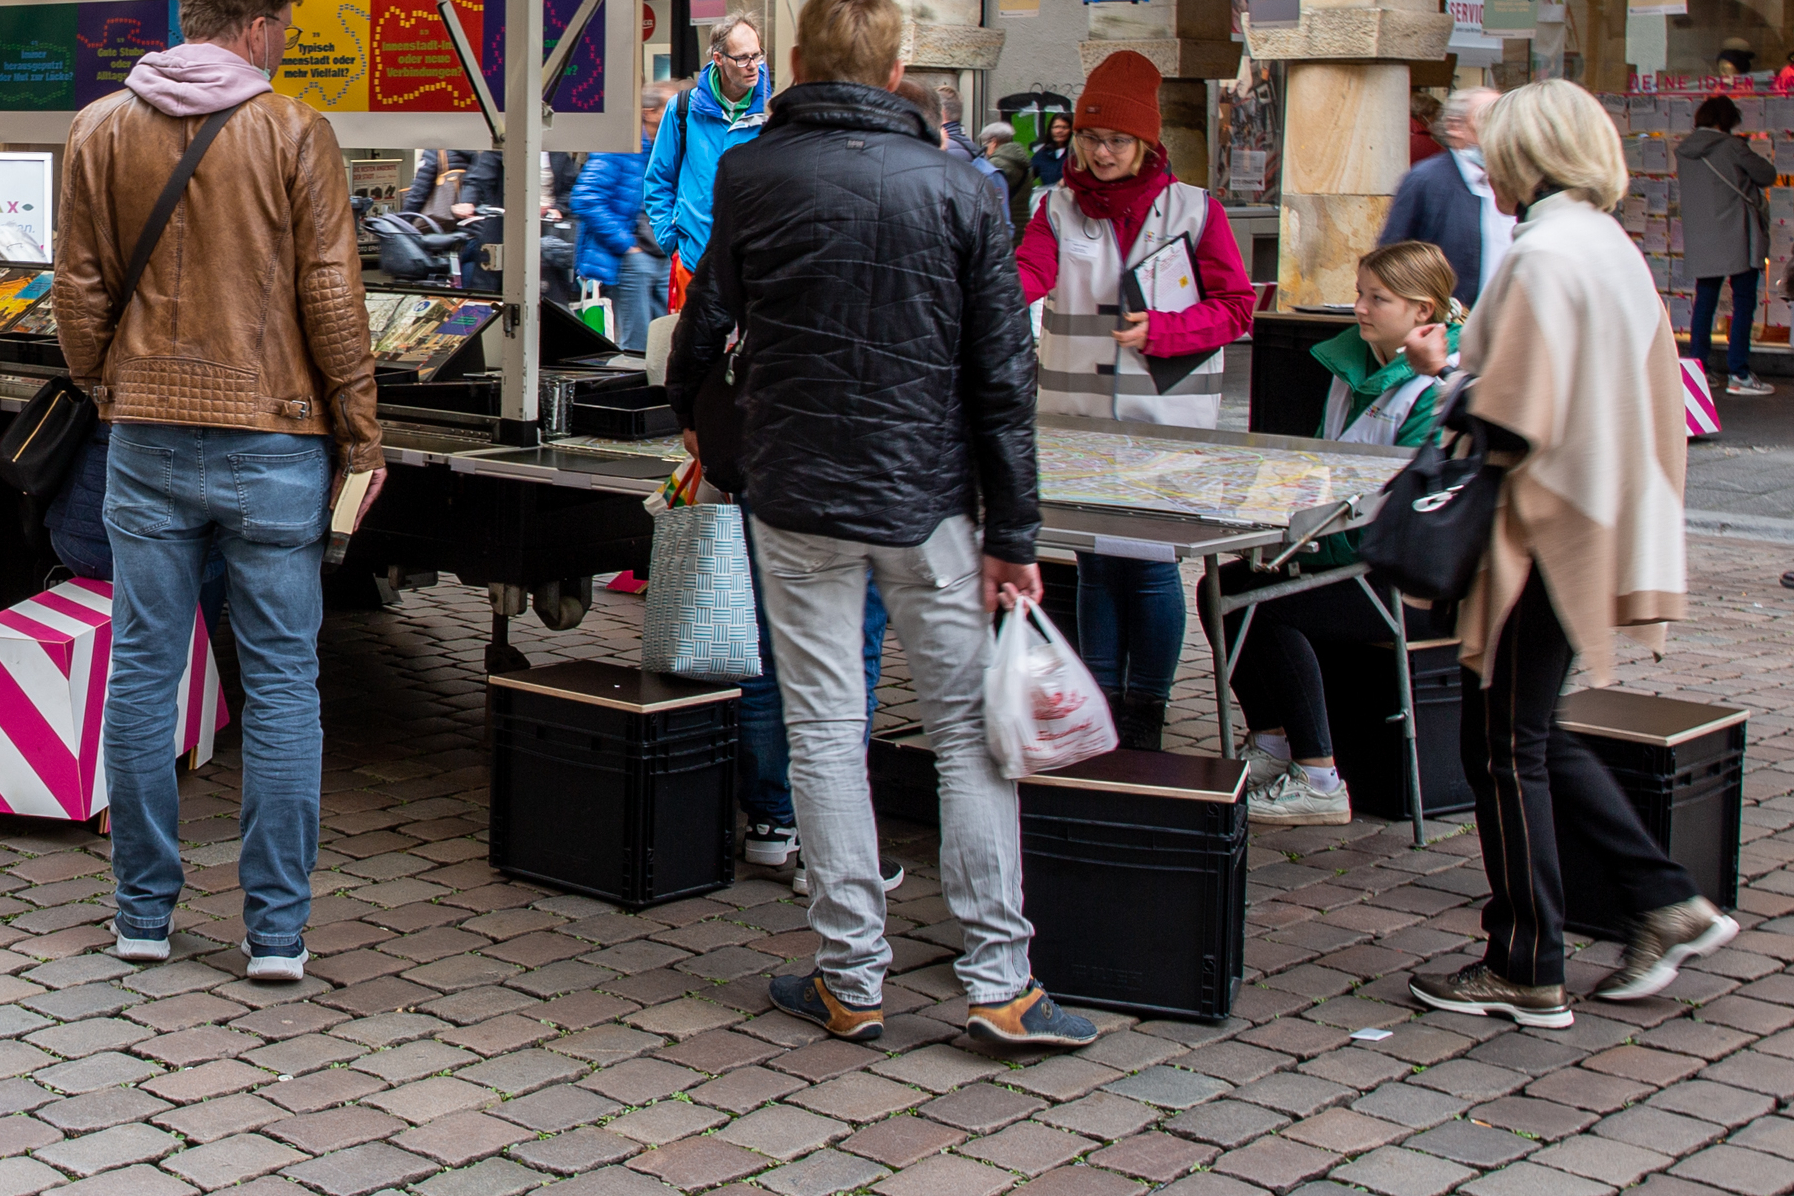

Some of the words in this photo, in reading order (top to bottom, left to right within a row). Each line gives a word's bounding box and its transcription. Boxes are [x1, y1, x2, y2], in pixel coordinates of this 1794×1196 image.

[97, 47, 118, 58] Gute
[119, 46, 146, 57] Stube
[298, 42, 335, 53] Typisch
[382, 41, 456, 52] Innenstadt-In
[110, 58, 132, 69] oder
[279, 55, 331, 66] nnenstadt
[332, 55, 356, 65] oder
[398, 54, 423, 64] oder
[424, 54, 451, 64] neue
[284, 68, 309, 78] mehr
[310, 67, 350, 78] Vielfalt?
[386, 67, 463, 79] Verbindungen?
